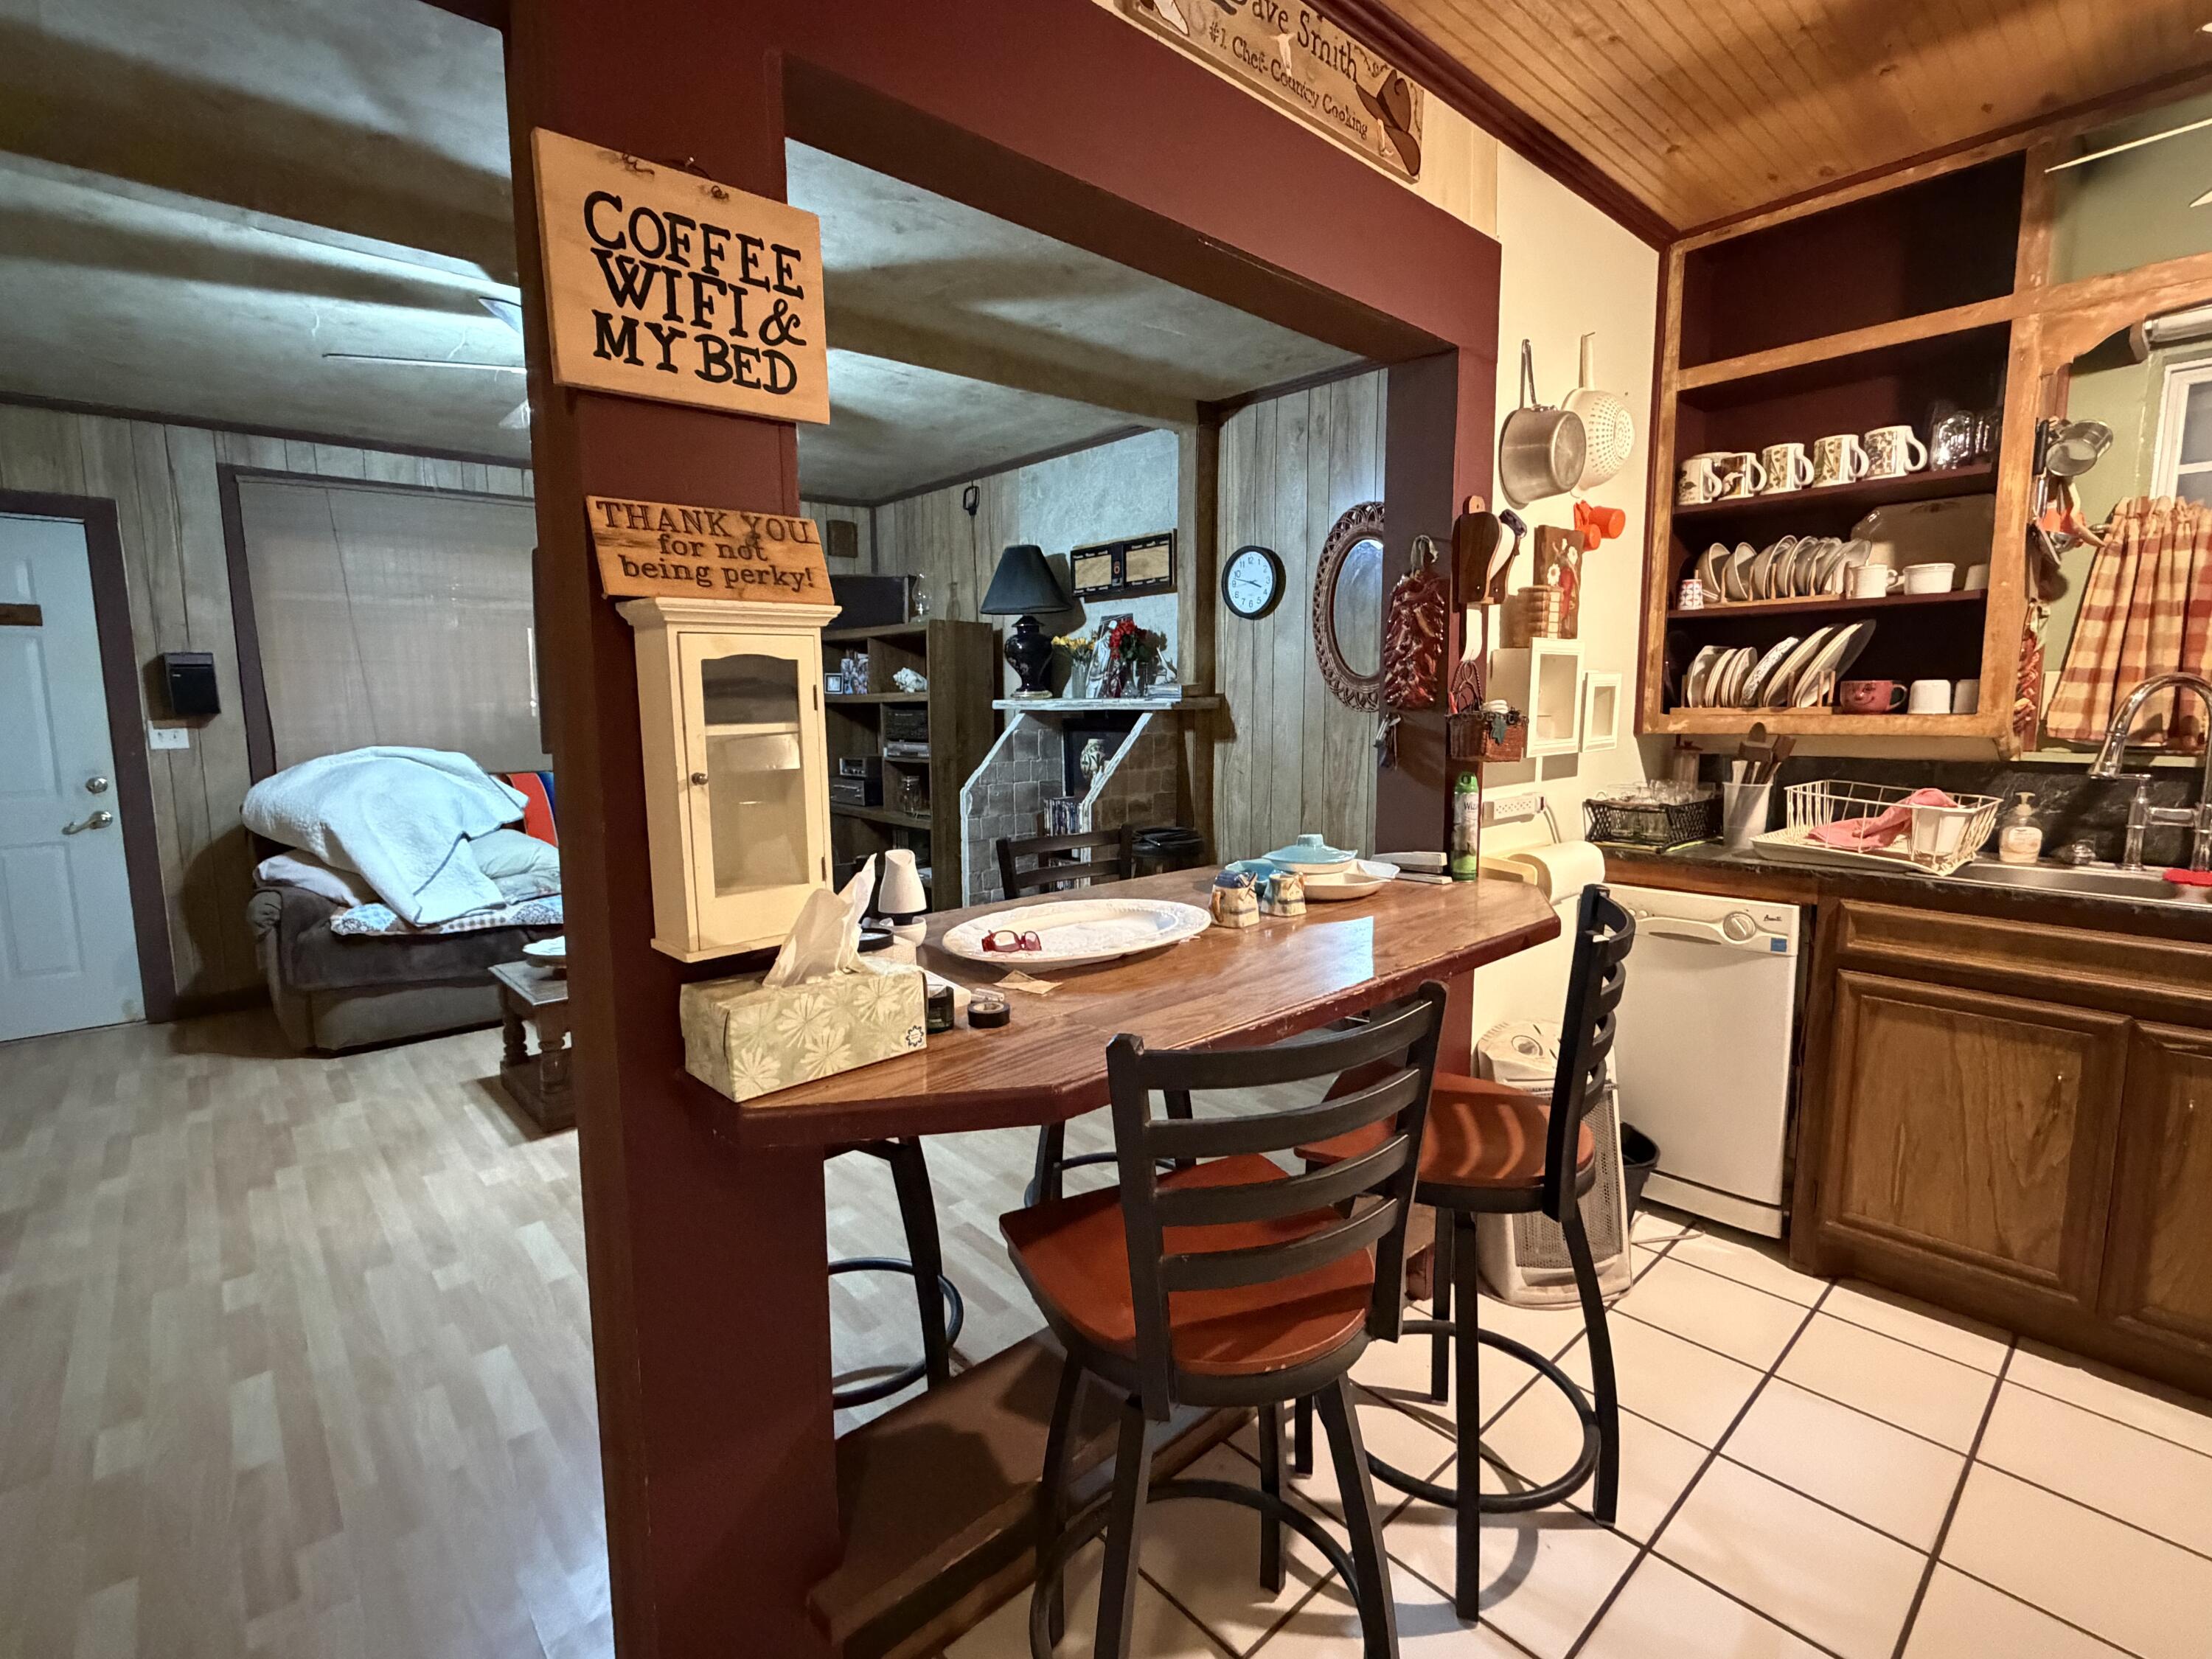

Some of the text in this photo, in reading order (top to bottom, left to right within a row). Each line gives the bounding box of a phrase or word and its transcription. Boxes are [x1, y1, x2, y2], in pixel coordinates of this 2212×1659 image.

[1252, 0, 1357, 83] ave Smith
[1322, 93, 1368, 140] Cooking
[584, 190, 804, 299] COFFEE
[591, 248, 807, 347] WIFI &
[591, 309, 797, 395] MY BED
[596, 500, 821, 546] THANK YOU
[658, 534, 768, 562] for not
[618, 554, 815, 593] being perky!
[1231, 580, 1237, 588] 9
[1234, 570, 1241, 578] 10
